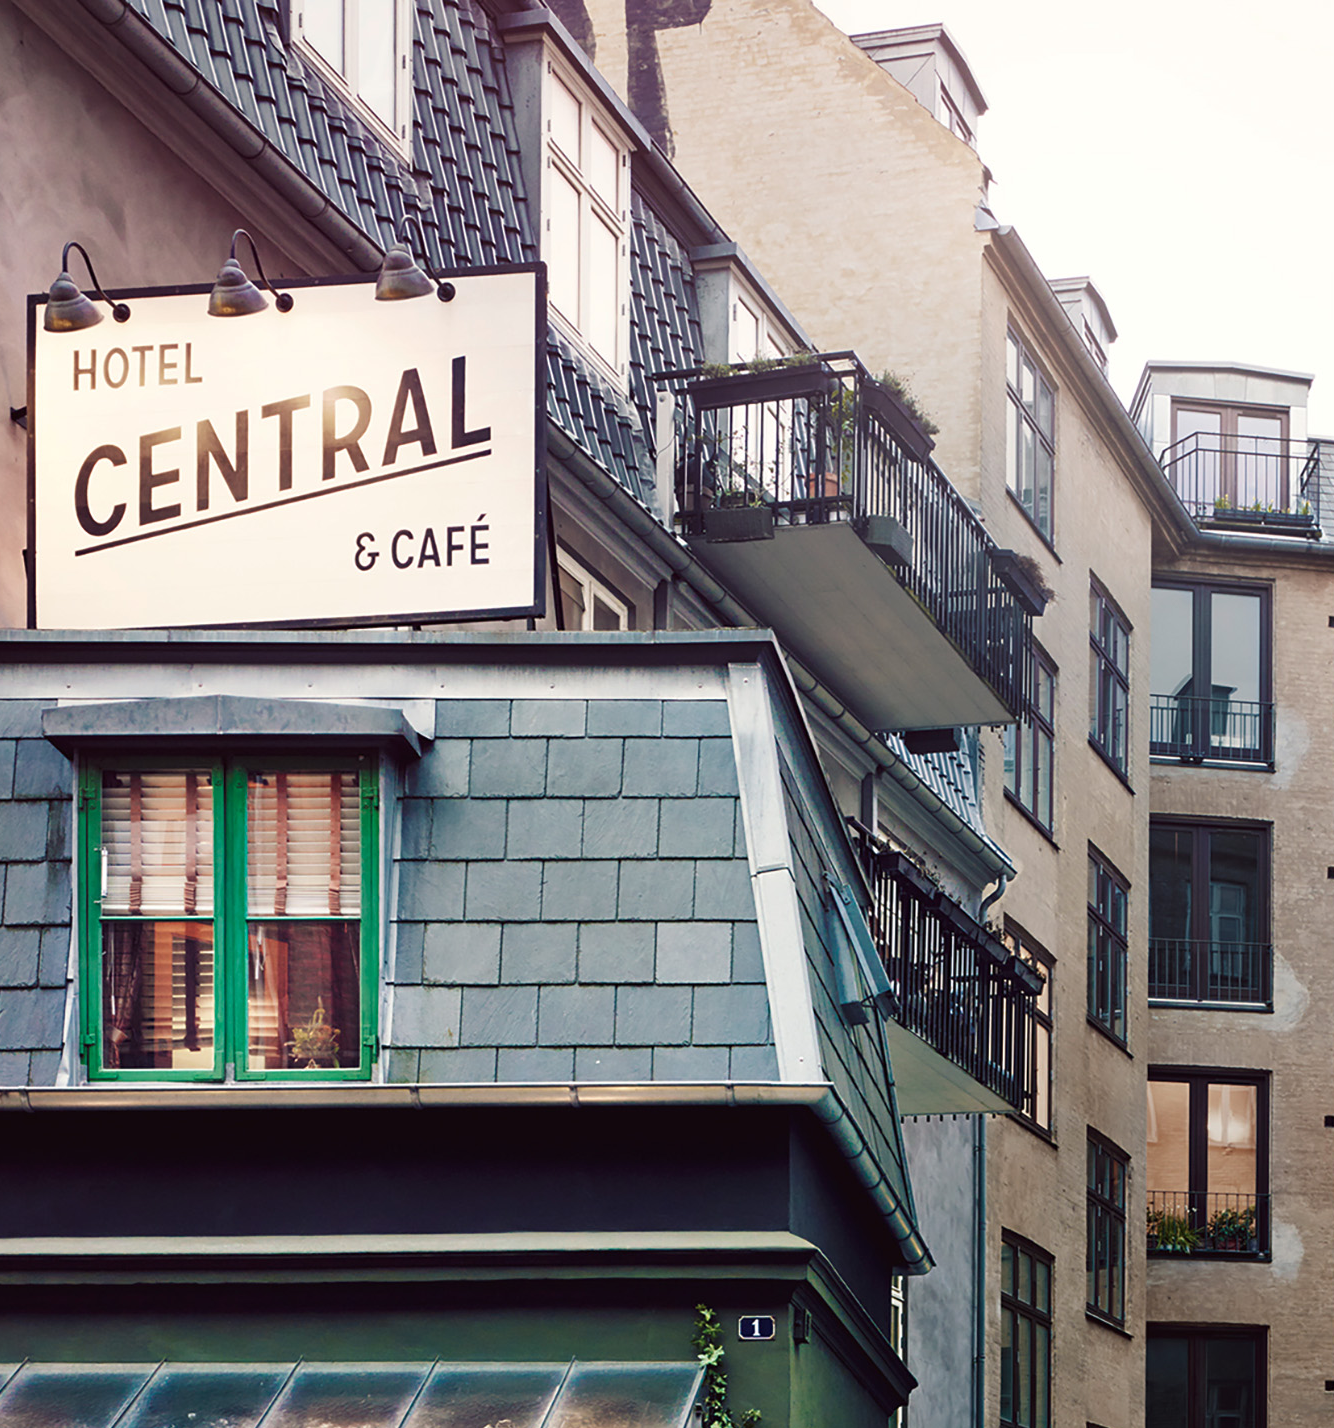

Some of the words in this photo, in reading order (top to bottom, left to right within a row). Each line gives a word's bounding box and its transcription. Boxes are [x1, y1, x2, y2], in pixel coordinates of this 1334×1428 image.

[72, 342, 203, 391] HOTEL
[74, 355, 492, 537] CENTRAL
[355, 531, 380, 572] &
[391, 513, 490, 569] CAFÉ
[751, 1318, 761, 1337] 1
